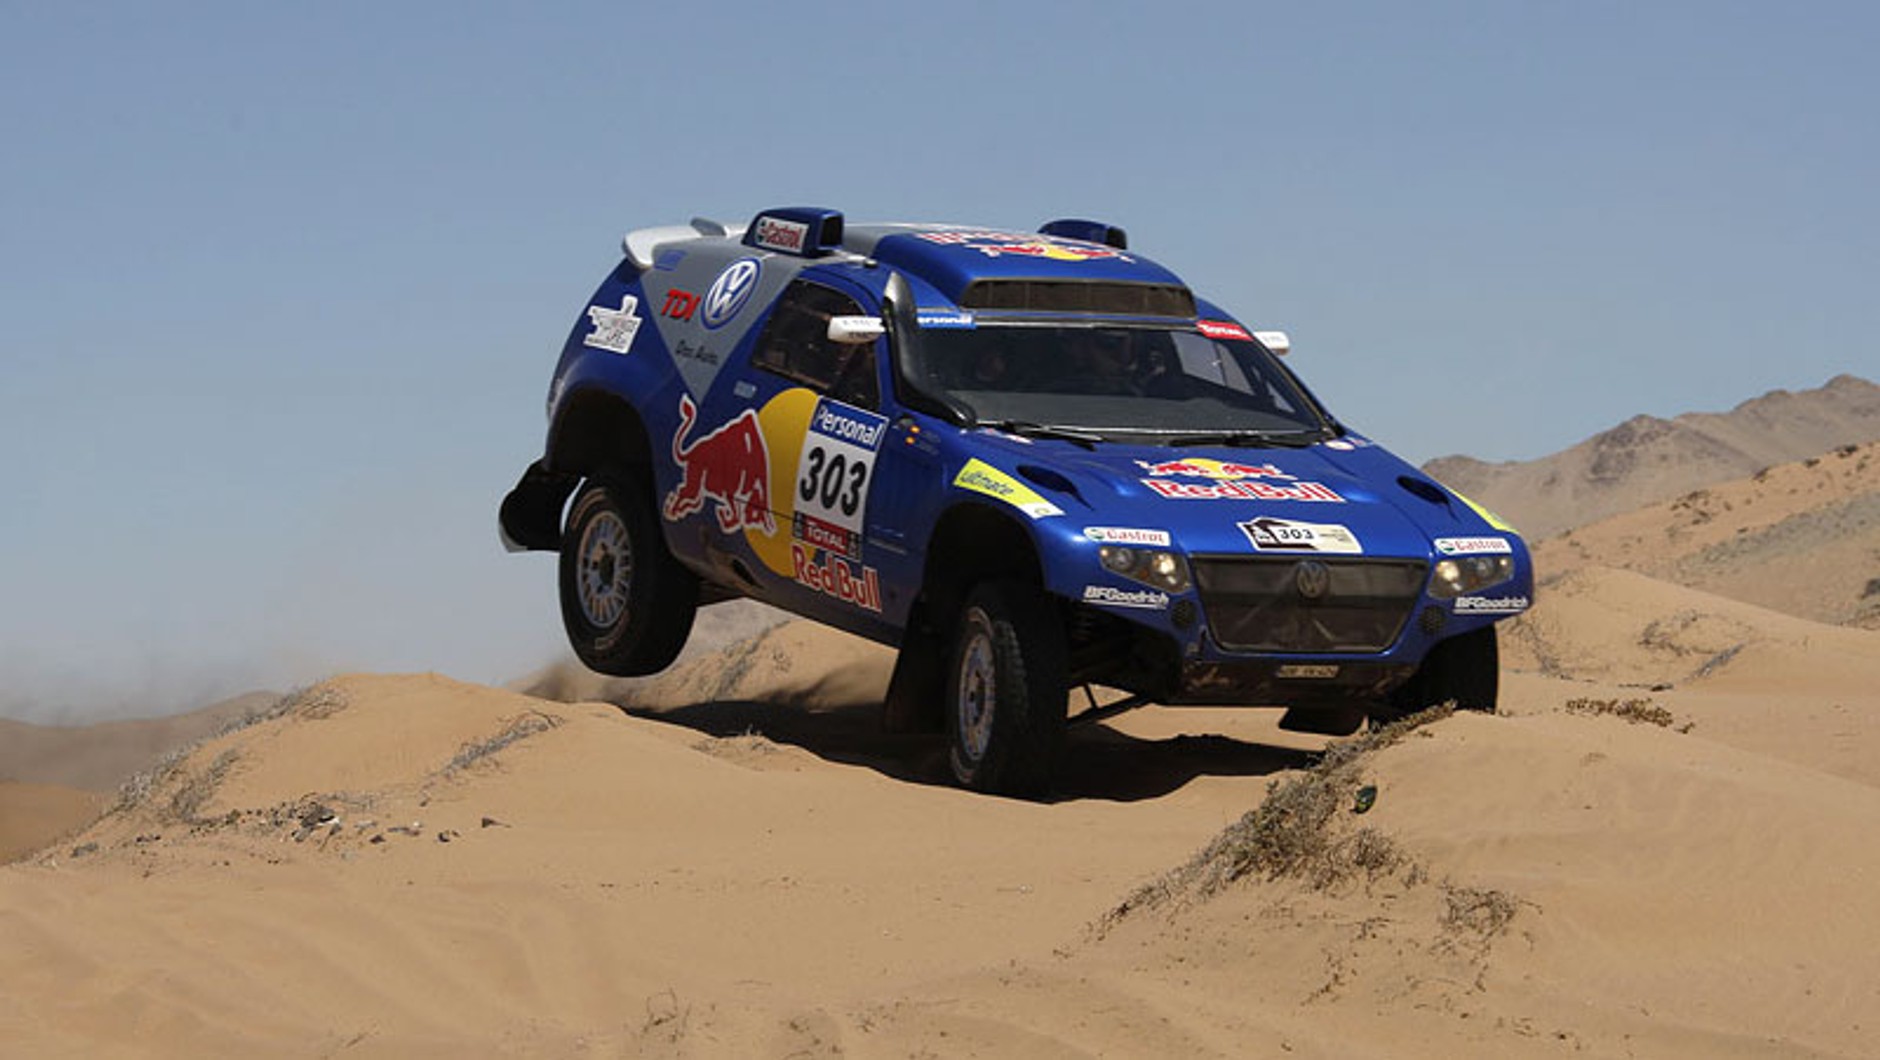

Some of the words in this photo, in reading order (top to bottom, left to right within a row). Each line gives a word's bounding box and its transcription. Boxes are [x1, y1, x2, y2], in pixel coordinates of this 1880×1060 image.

[662, 289, 701, 321] TDI
[917, 311, 973, 325] ersonal
[815, 404, 881, 447] Personal
[800, 446, 867, 516] 303
[1139, 479, 1256, 499] Red
[1237, 481, 1347, 503] Bull
[807, 521, 845, 549] TOTAL
[1278, 528, 1315, 540] 303
[791, 542, 838, 598] Red
[836, 557, 882, 613] Bull
[1082, 584, 1169, 608] BFGoodrich
[1454, 596, 1529, 612] BFGoodrich
